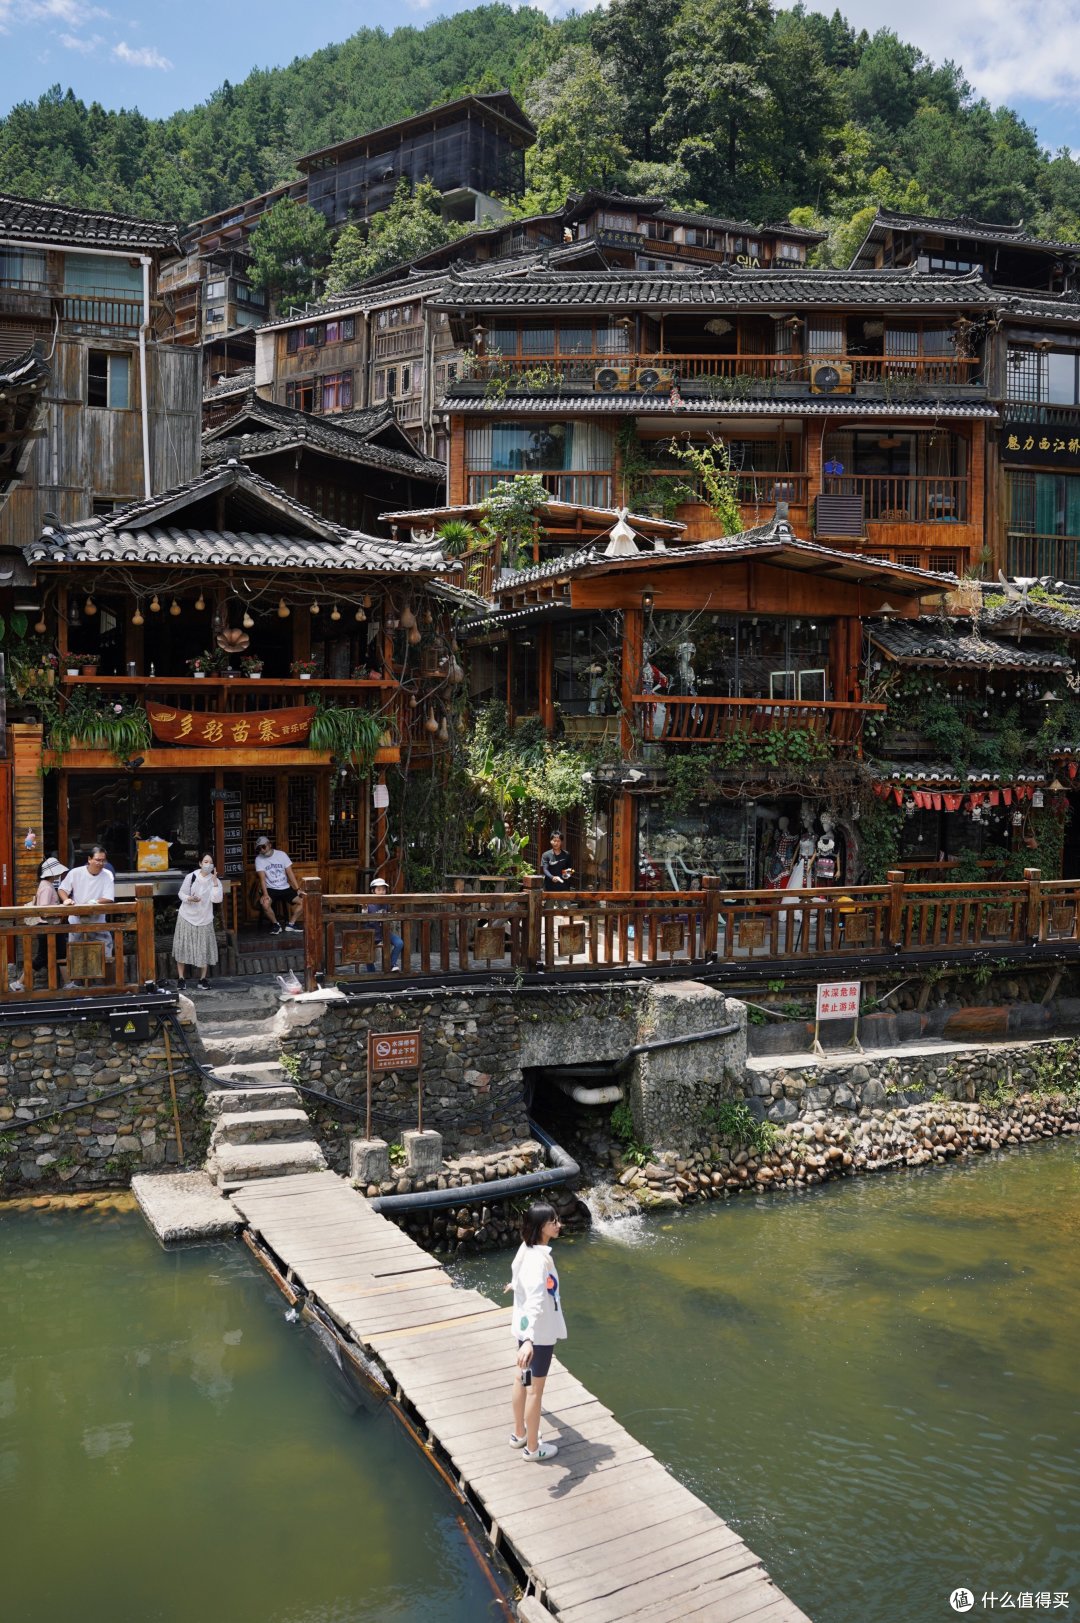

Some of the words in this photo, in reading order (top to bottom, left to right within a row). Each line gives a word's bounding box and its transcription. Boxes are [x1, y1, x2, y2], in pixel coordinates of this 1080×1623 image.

[174, 713, 281, 743] 多彩苗寨
[281, 722, 309, 736] 音乐吧
[822, 987, 857, 998] 水深危险
[821, 1001, 856, 1013] 禁止游泳
[391, 1047, 415, 1055] 禁止下河
